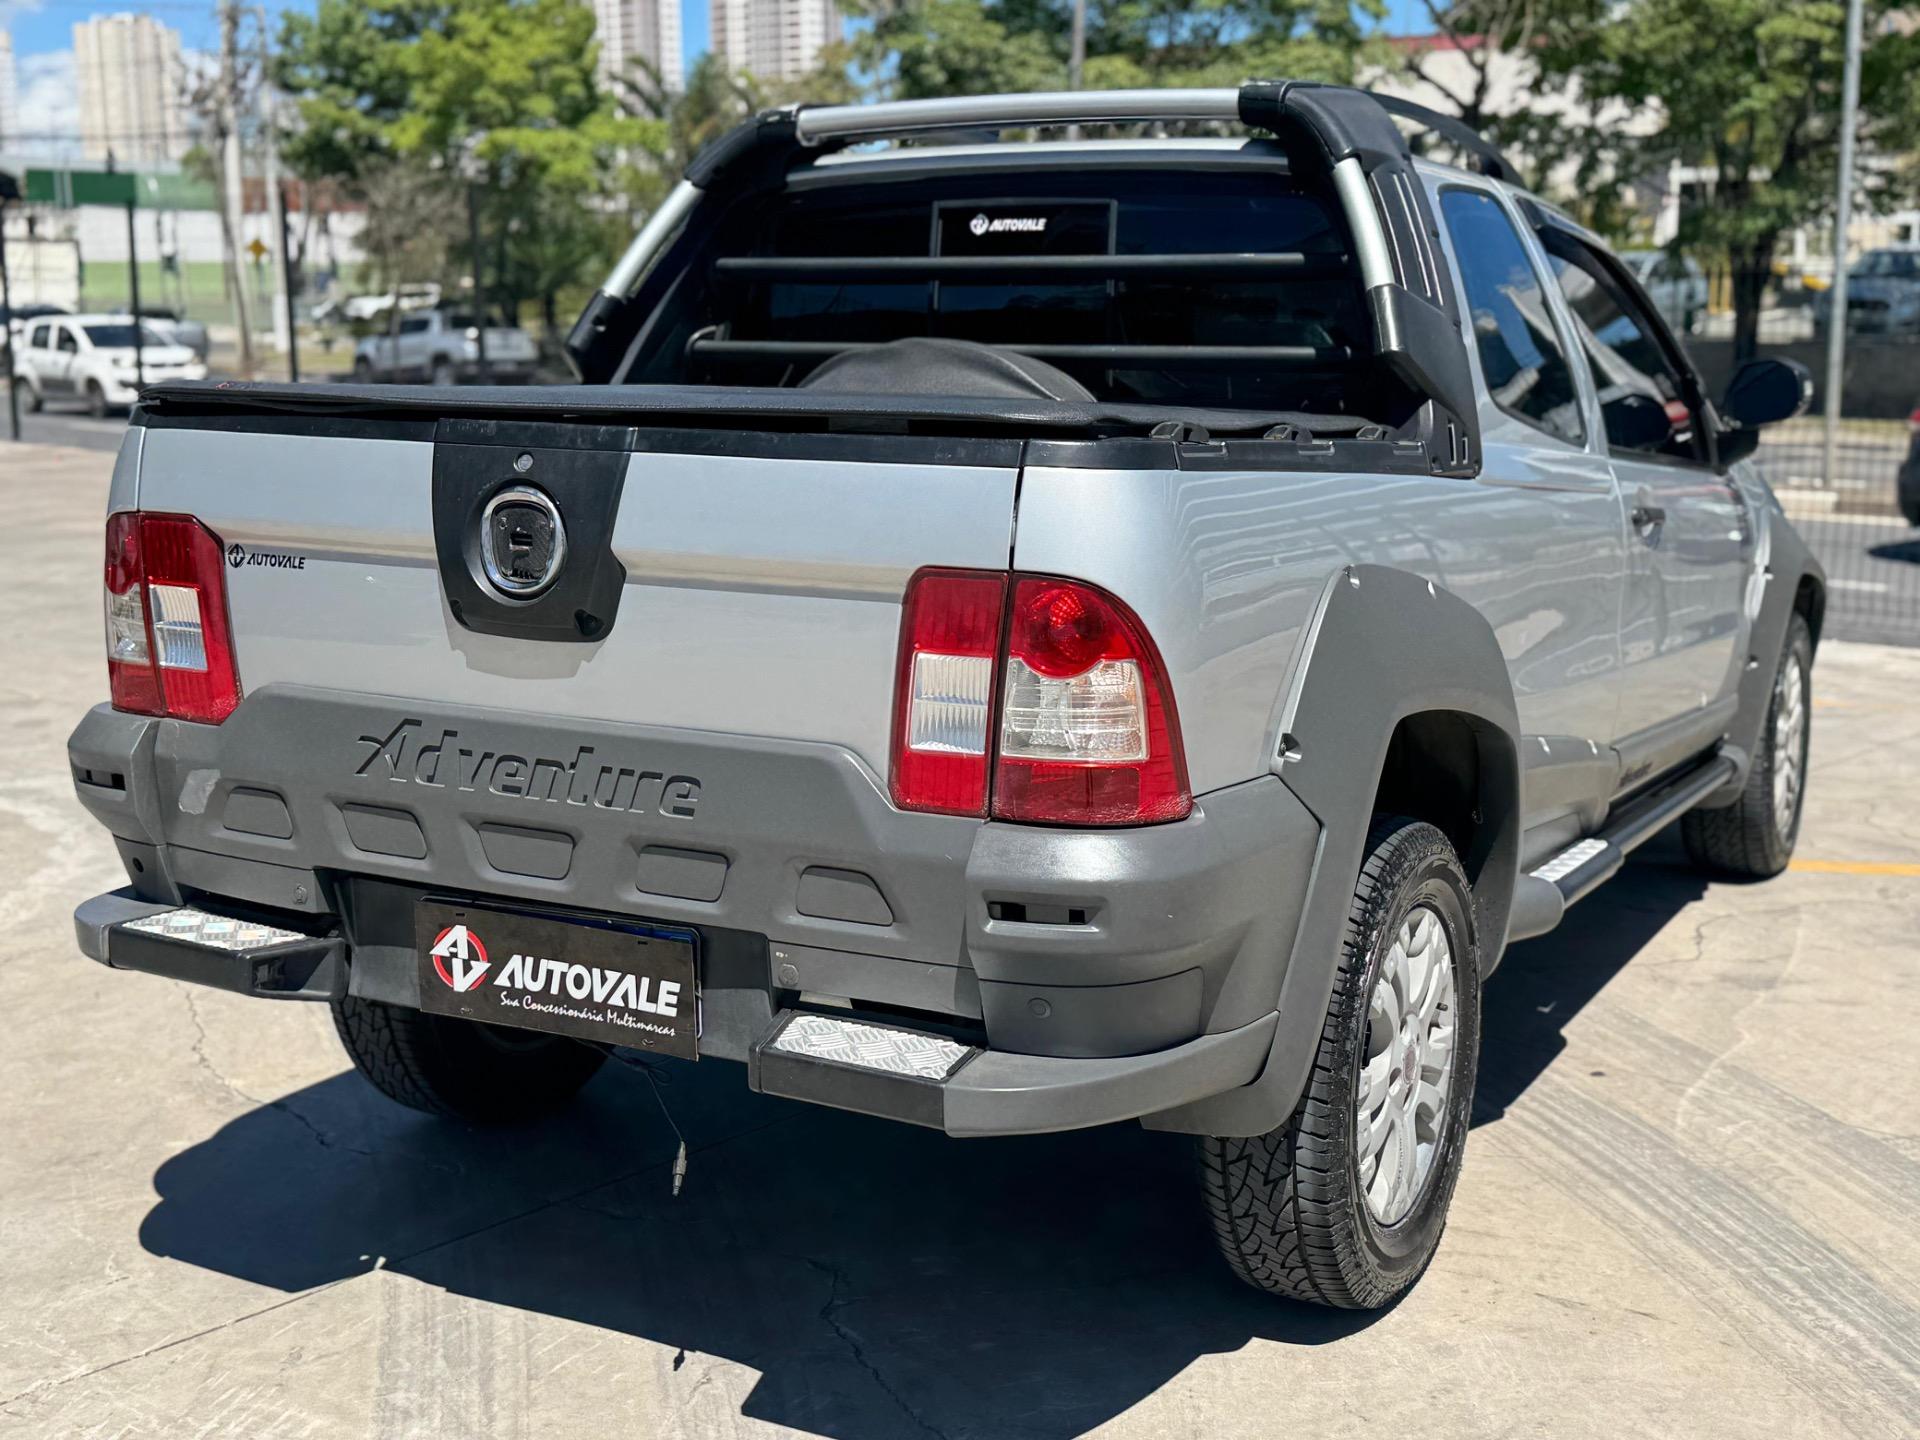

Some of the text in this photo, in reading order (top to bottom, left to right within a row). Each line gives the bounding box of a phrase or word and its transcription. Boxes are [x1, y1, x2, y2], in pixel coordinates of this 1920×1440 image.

[988, 218, 1047, 231] AUTOVALE
[247, 553, 306, 570] AUTOVALE
[354, 718, 701, 819] Adventure
[493, 954, 681, 1017] AUTOVALE
[500, 991, 520, 1006] Sua
[607, 1009, 676, 1036] Multimarcas
